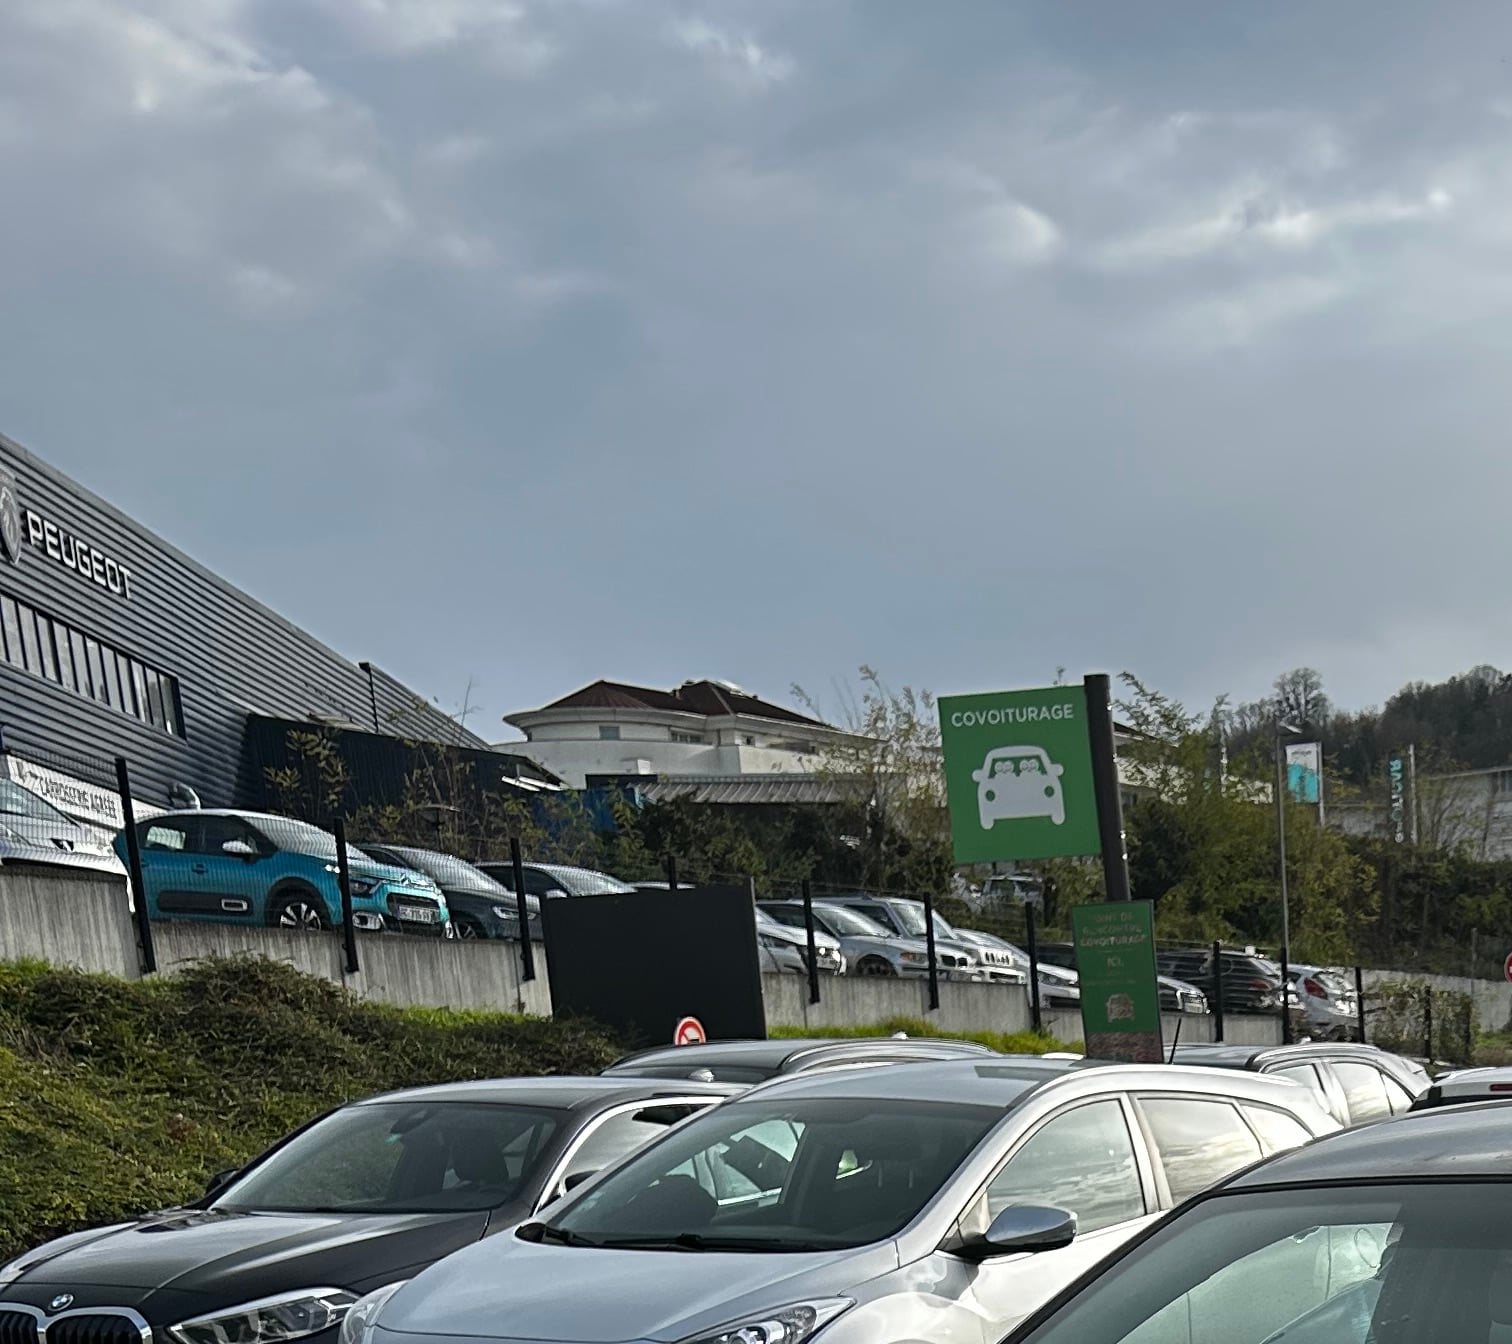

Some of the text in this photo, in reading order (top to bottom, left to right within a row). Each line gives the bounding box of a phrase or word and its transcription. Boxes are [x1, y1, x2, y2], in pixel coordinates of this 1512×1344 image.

[26, 510, 131, 600] PEUGEOT
[951, 704, 1074, 727] COVOITURAGE
[1080, 934, 1146, 948] COVOITURAGE
